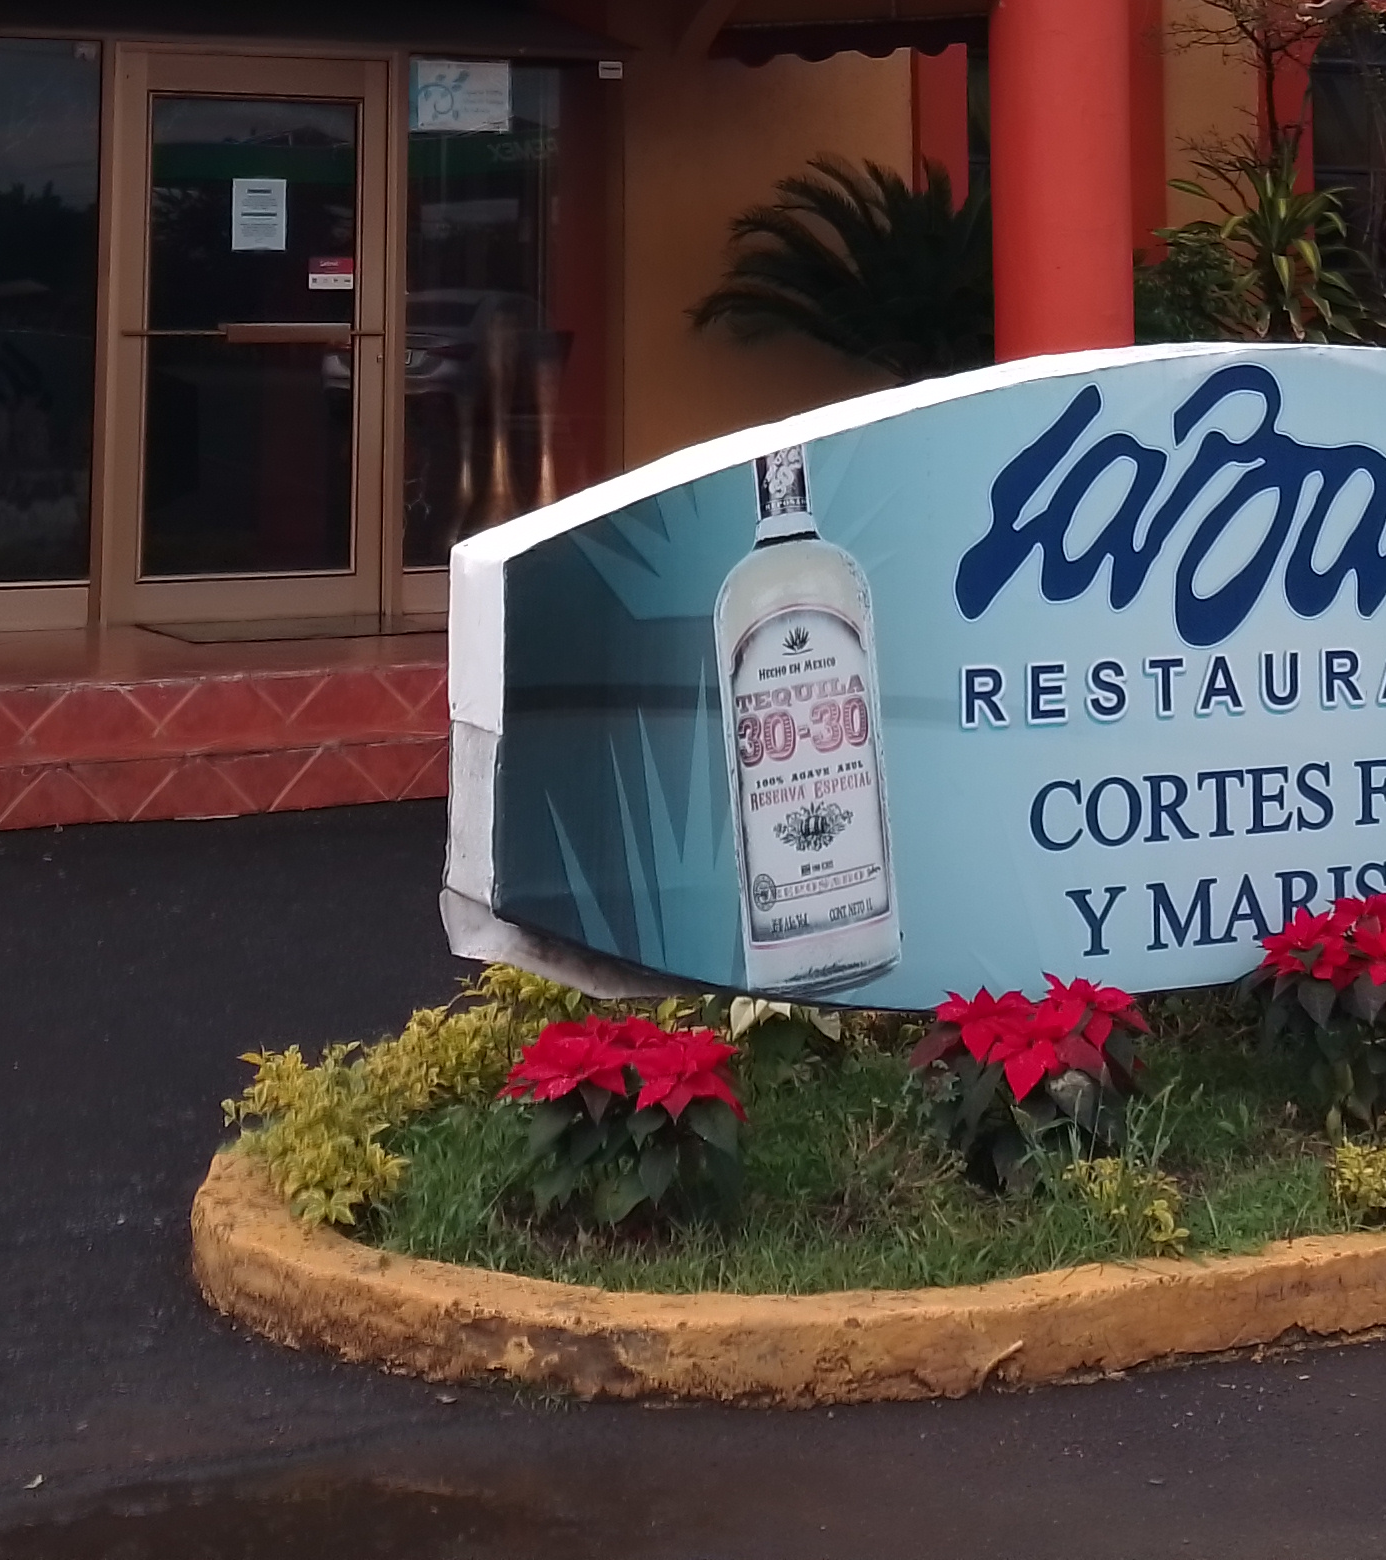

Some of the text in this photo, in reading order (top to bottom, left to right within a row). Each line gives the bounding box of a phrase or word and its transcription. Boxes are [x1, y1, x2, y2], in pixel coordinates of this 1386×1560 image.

[758, 665, 787, 681] HECHO
[803, 657, 836, 672] MEXICO
[736, 674, 865, 714] TEQUILA
[737, 698, 870, 767] 30-30
[749, 772, 873, 812] RESERVA ESPECIAL
[755, 760, 864, 790] 100% AGAVE AZUL
[1029, 760, 1335, 853] CORTES
[1065, 885, 1127, 957] Y
